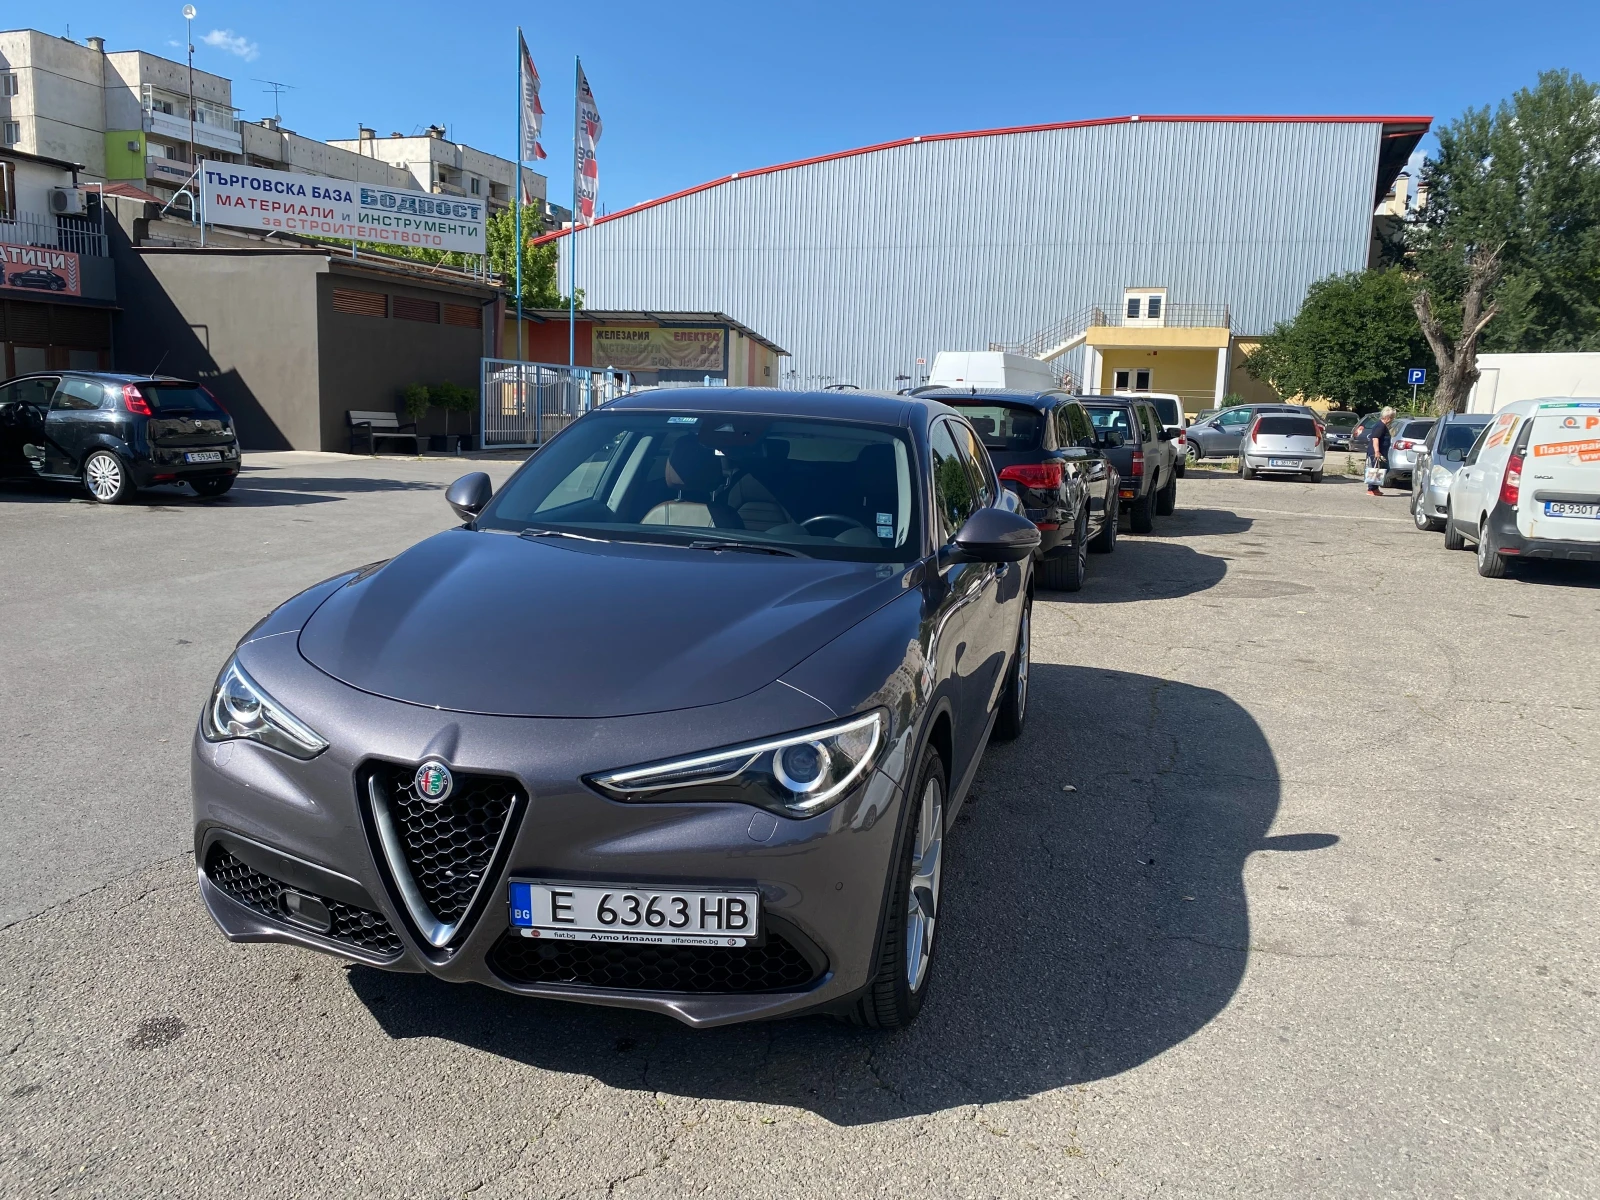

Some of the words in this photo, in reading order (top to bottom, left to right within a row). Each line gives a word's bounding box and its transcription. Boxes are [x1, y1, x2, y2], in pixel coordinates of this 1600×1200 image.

[206, 171, 306, 197] ТЪРГОВСКА
[312, 186, 353, 204] БАЗА
[216, 194, 334, 220] МАТЕРИАЛИ
[342, 212, 350, 222] и
[358, 212, 478, 237] ИНСТРУМЕНТИ
[262, 217, 282, 226] за
[286, 218, 442, 246] СТРОИТЕЛСТВОТО
[596, 330, 650, 340] ЖЕЛЕЗАРИЯ
[674, 332, 720, 342] ЕЛЕКТРО
[1412, 371, 1422, 382] P
[1552, 504, 1565, 513] CB
[1569, 504, 1593, 515] 9301
[514, 910, 530, 920] BG
[551, 890, 574, 923] E
[597, 893, 690, 928] 6363
[700, 896, 748, 930] HB
[554, 931, 576, 940] fiat.bg
[670, 937, 719, 946] alfaromeo.bg
